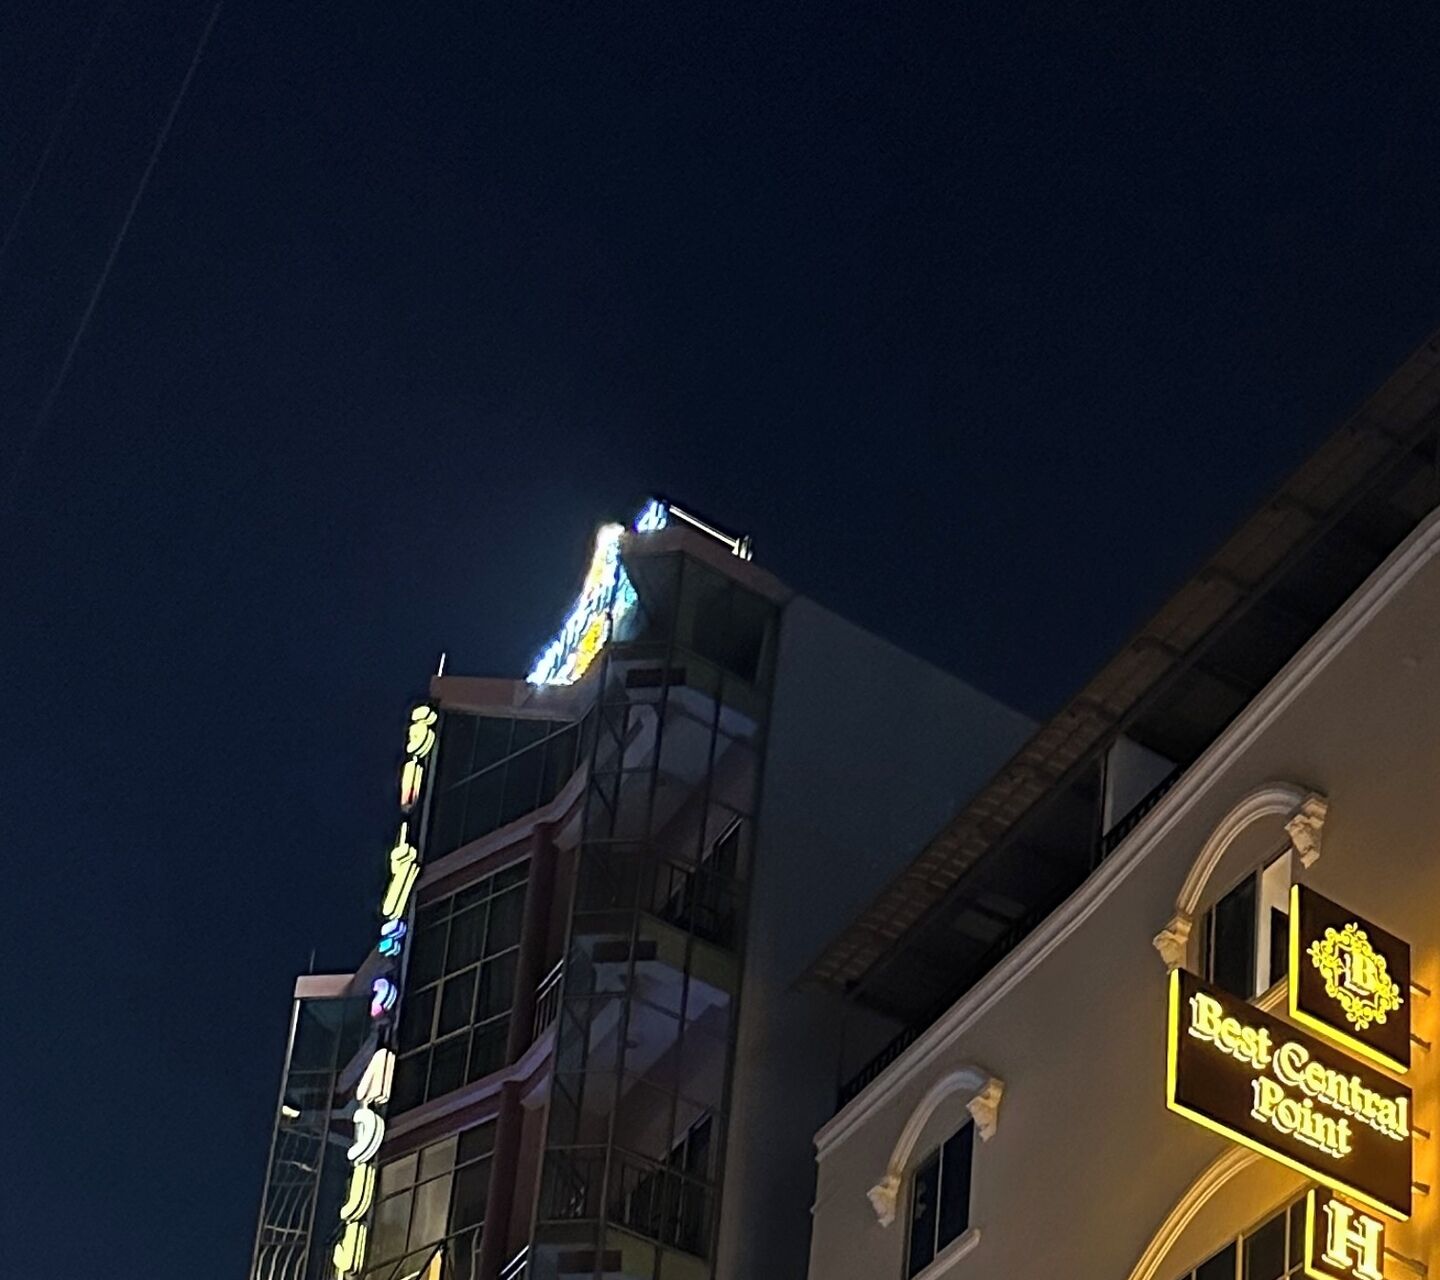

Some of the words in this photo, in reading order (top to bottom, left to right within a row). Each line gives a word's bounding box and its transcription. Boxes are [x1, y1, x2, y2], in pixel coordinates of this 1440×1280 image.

[1188, 992, 1272, 1070] Best
[1273, 1041, 1410, 1141] Central
[1251, 1076, 1353, 1168] Point
